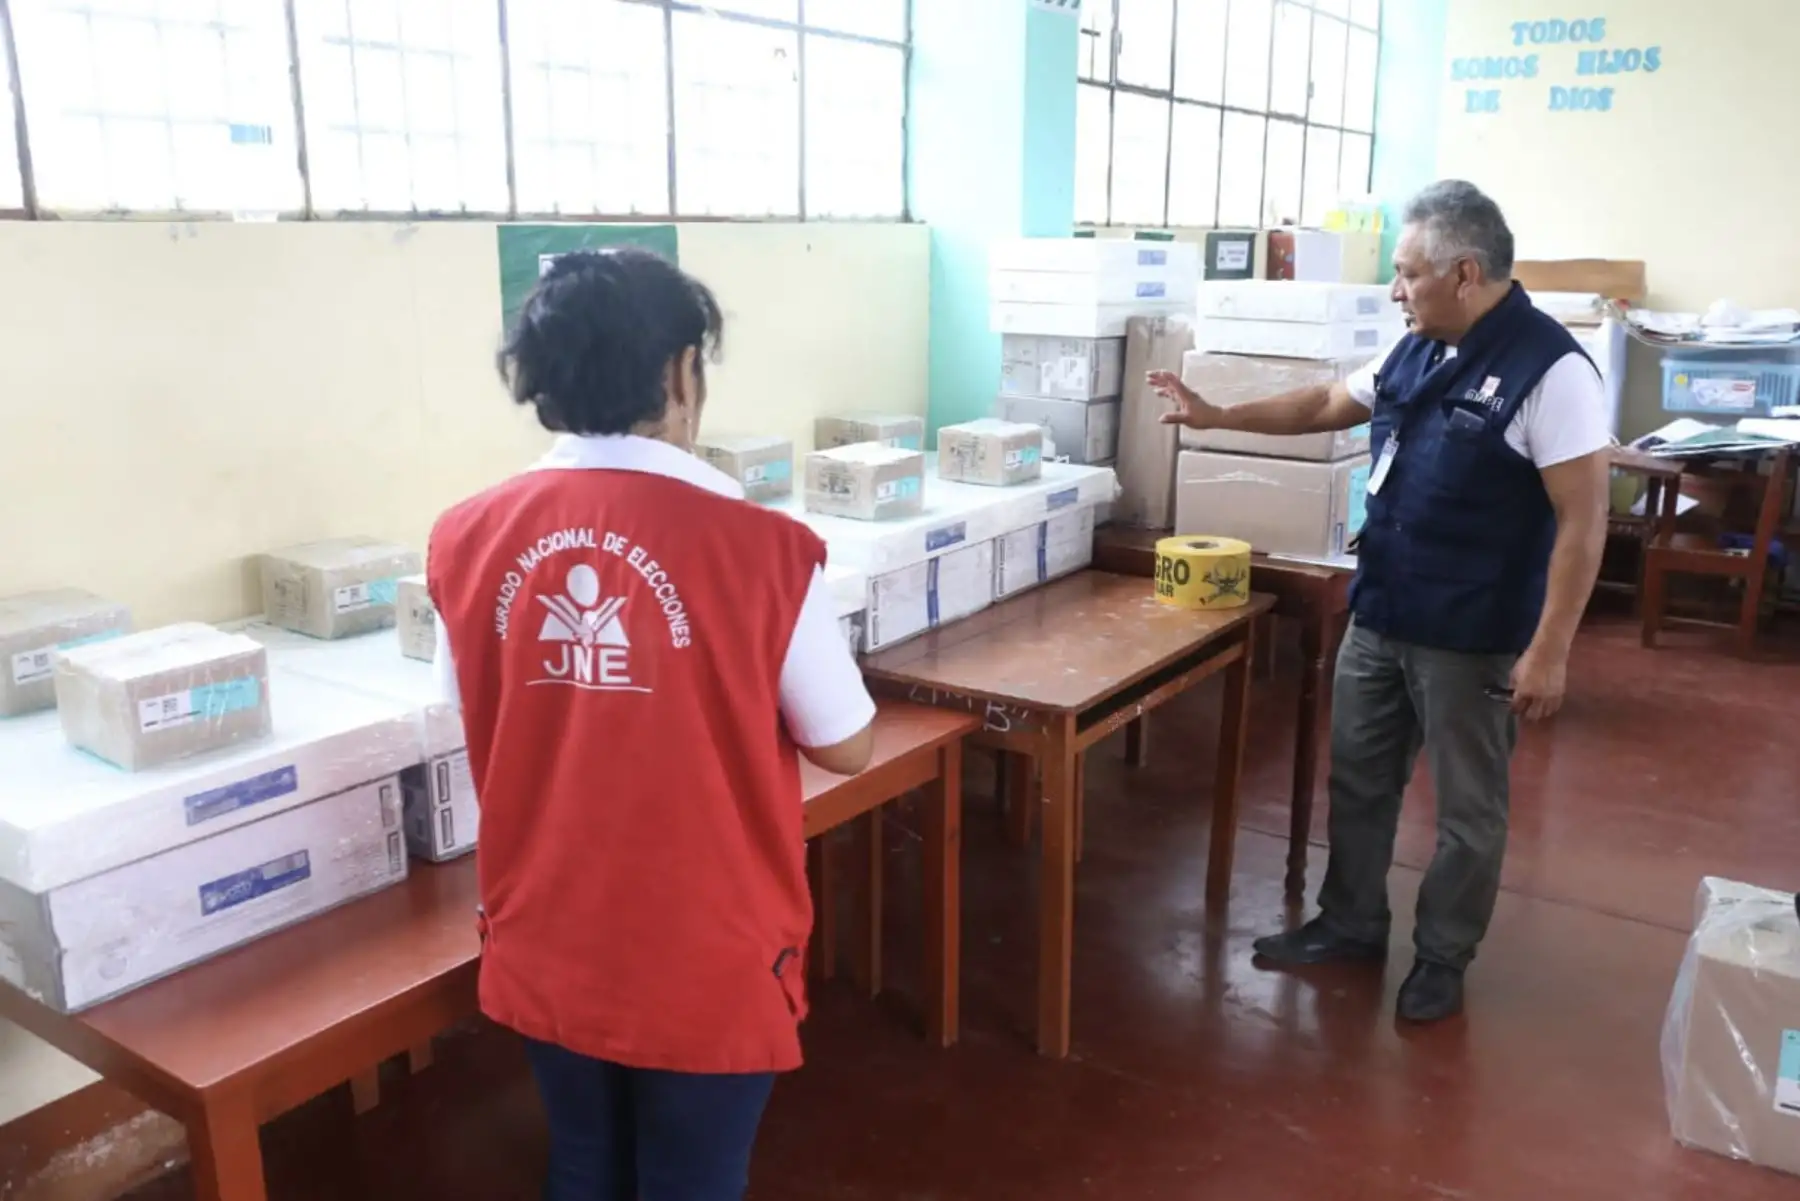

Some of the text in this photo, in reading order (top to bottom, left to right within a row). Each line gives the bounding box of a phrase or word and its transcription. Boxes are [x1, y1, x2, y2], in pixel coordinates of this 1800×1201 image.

[1511, 17, 1606, 46] TODOS
[1451, 46, 1662, 81] SOMOS HIJOS
[1465, 85, 1614, 113] DE DIOS
[495, 527, 692, 649] JURADO NACIONAL DE ELECCIONES
[543, 643, 632, 684] JNE
